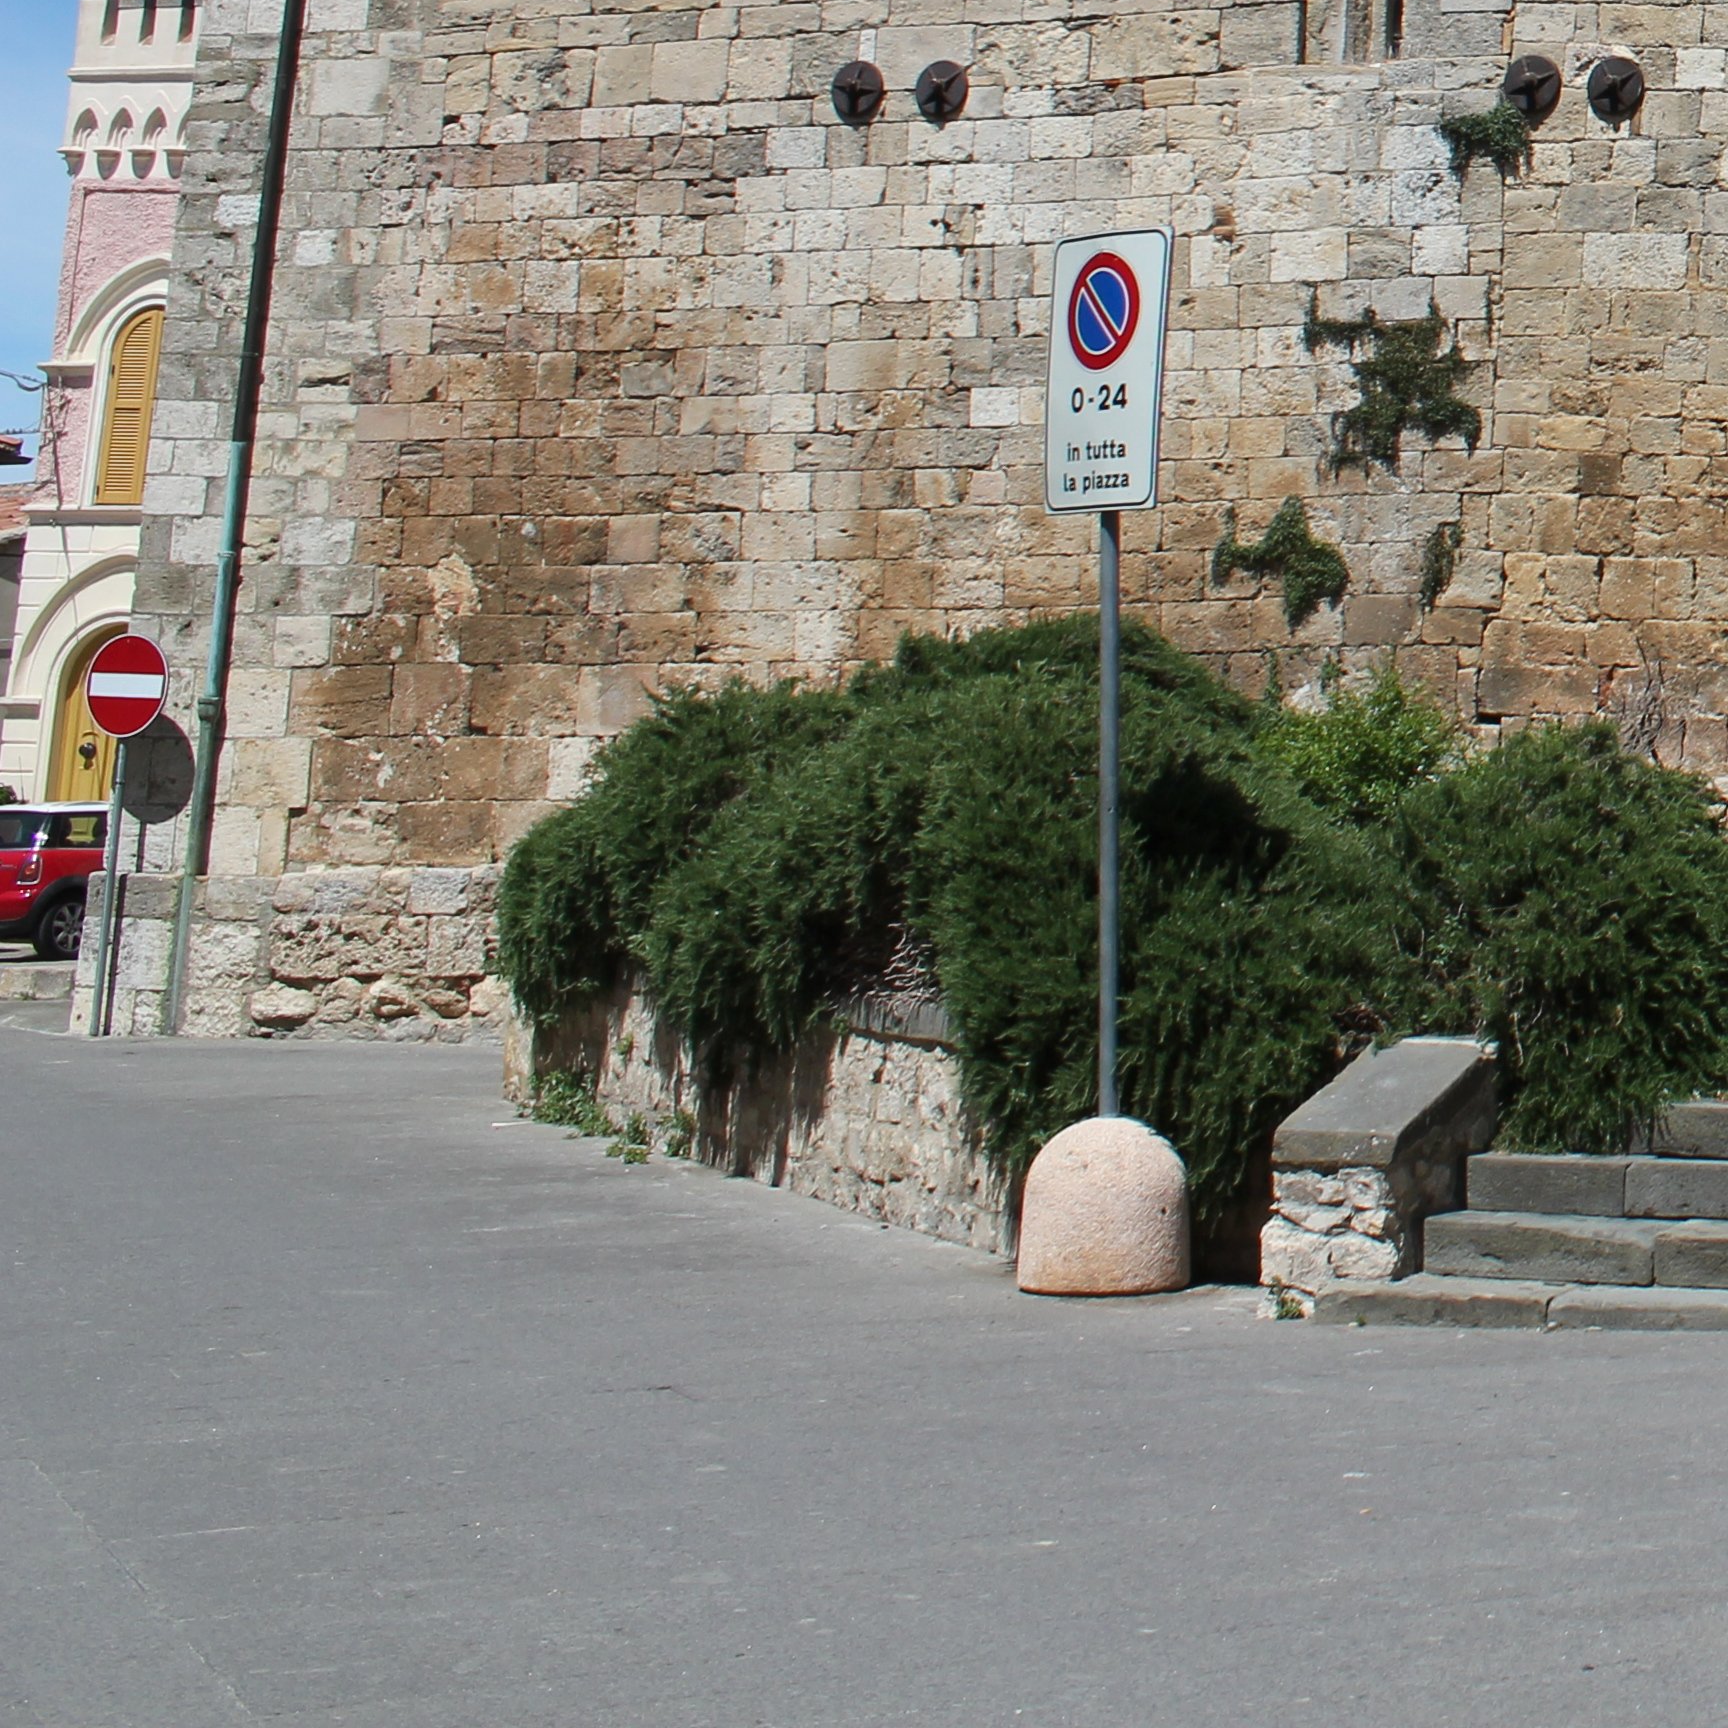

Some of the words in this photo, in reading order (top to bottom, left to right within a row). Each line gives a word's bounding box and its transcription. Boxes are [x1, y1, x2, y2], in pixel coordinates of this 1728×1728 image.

[1067, 442, 1081, 462] in
[1086, 439, 1127, 460] tutta
[1063, 473, 1077, 492] la
[1082, 471, 1130, 494] piazza
